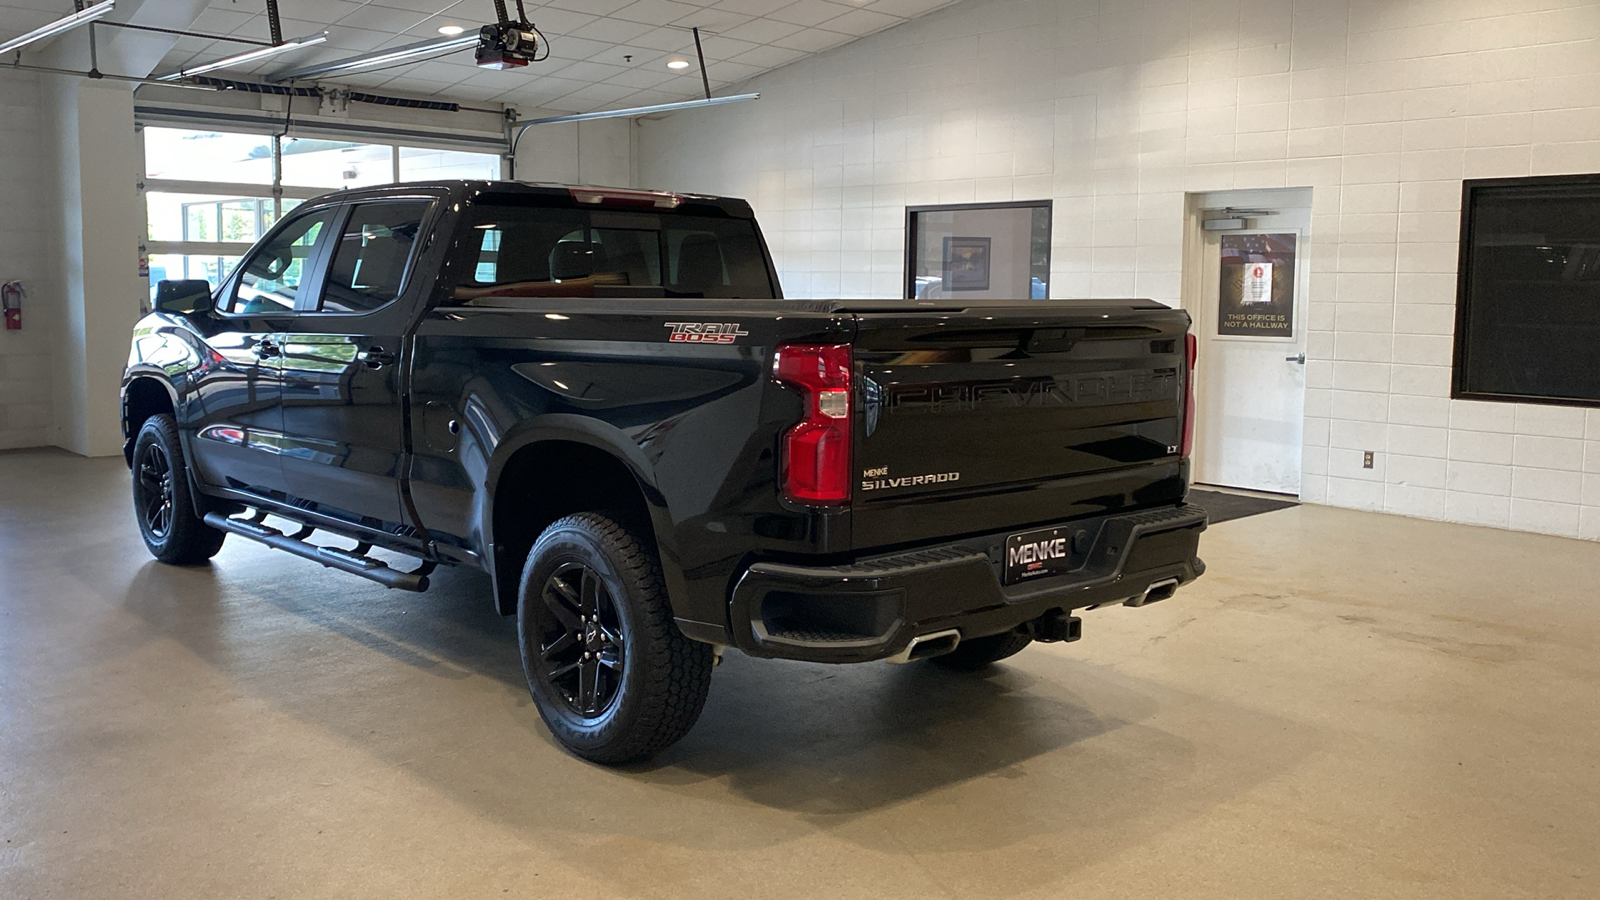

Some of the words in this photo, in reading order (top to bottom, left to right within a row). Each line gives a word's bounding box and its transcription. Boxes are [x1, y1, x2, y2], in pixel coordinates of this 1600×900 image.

[664, 322, 749, 336] TRAIL
[669, 333, 736, 344] BOSS
[890, 370, 1176, 414] CHEVROLET
[1167, 445, 1178, 454] LT
[863, 466, 888, 478] MENKE
[862, 472, 960, 490] SILVERADO
[1009, 538, 1065, 567] MENKE
